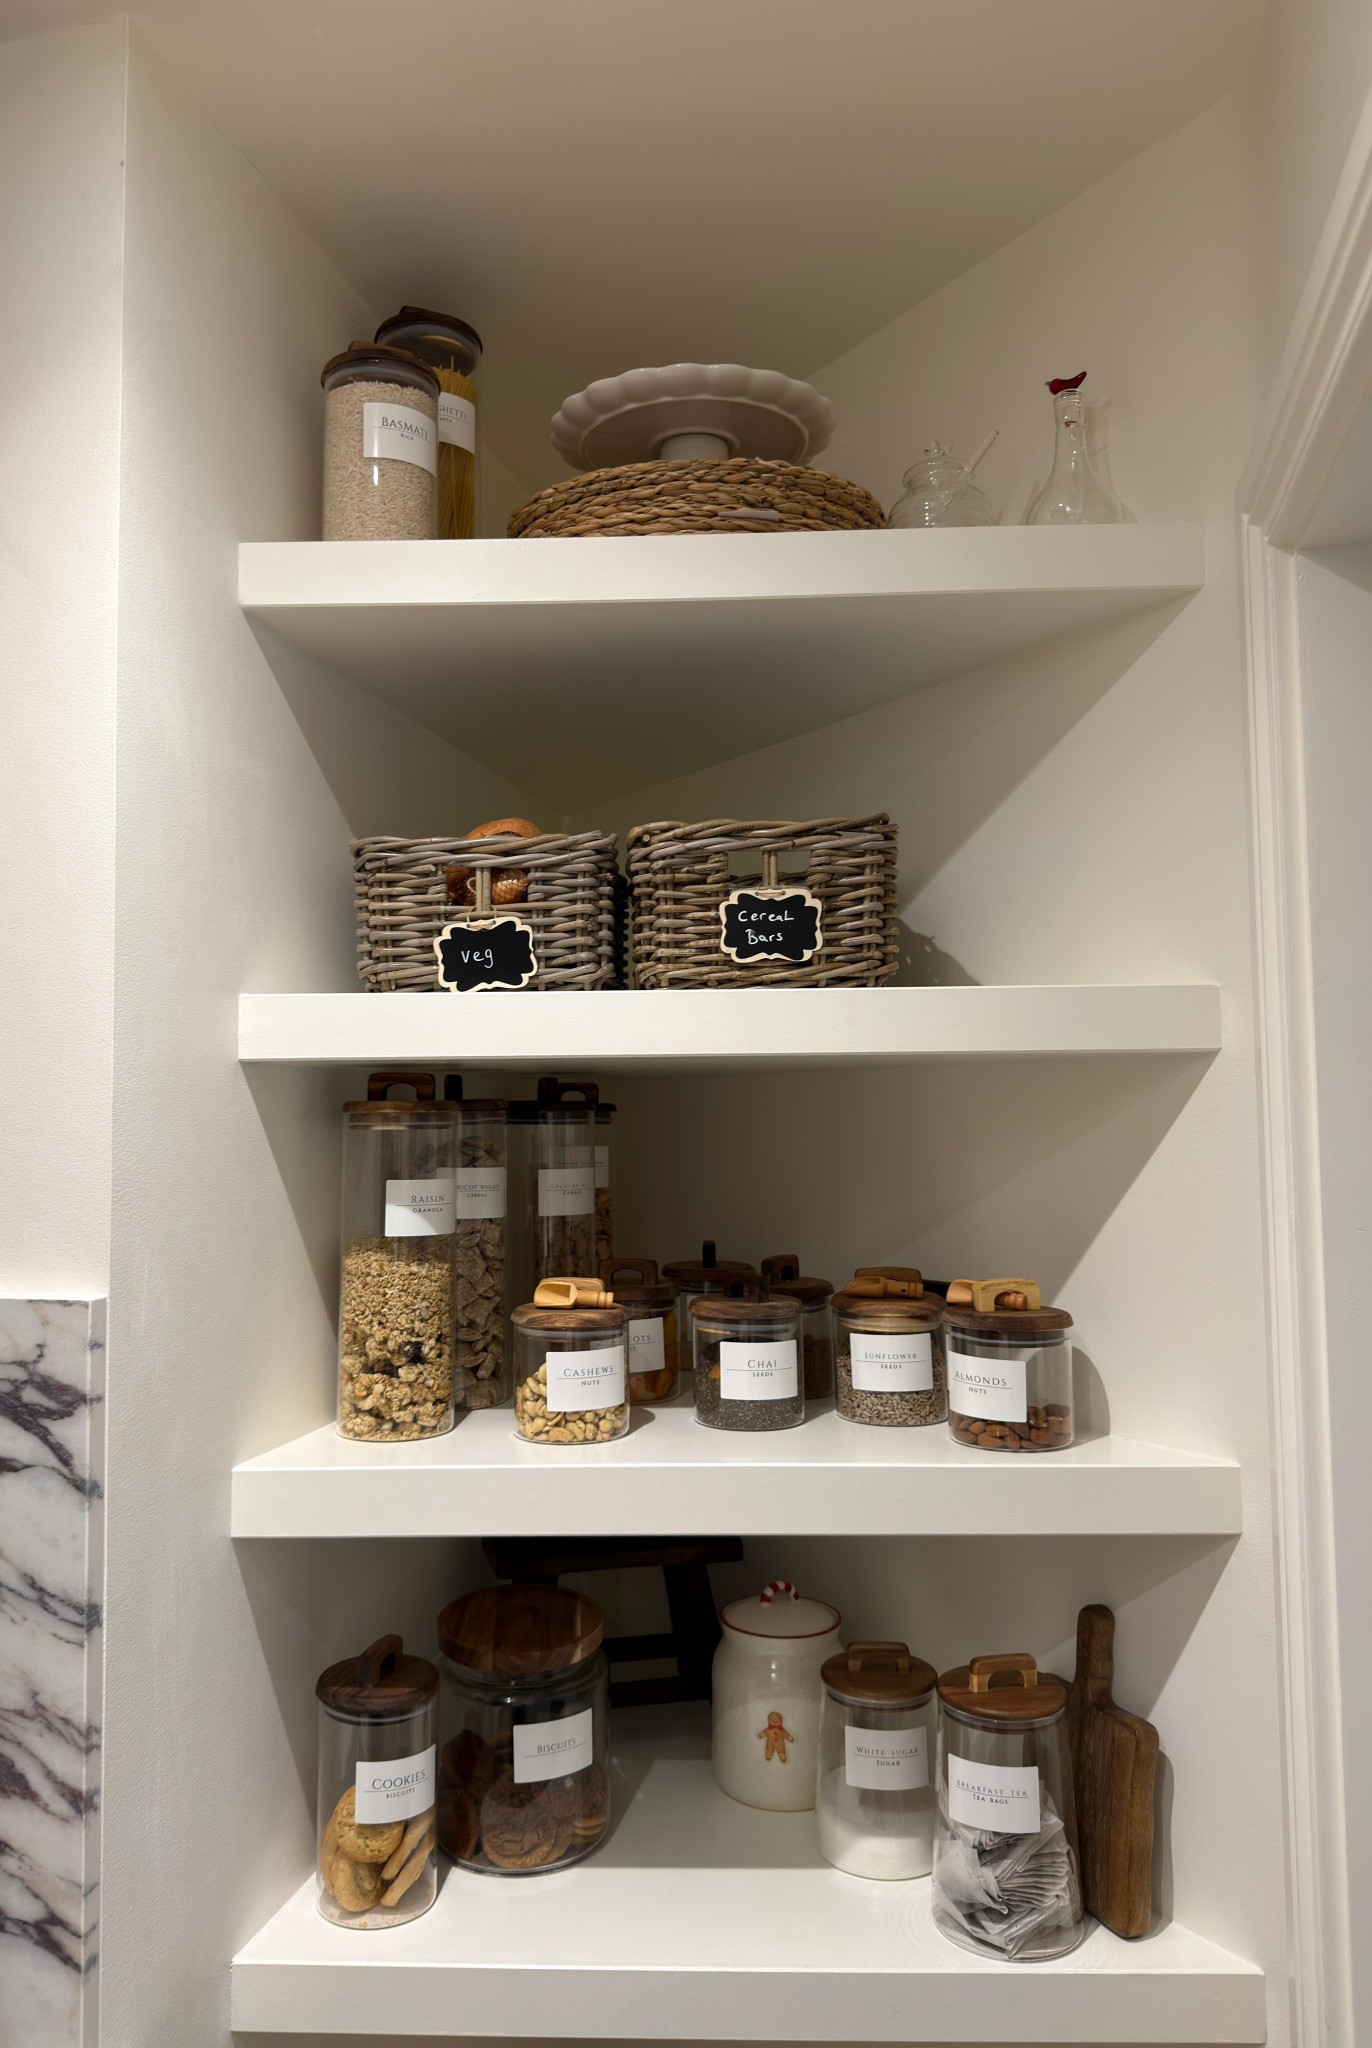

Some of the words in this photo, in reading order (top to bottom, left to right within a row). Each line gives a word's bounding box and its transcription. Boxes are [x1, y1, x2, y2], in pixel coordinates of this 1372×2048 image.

[381, 416, 428, 440] BASMATI
[400, 433, 414, 441] RICE
[745, 928, 783, 945] Bars
[460, 948, 494, 969] veg
[411, 1195, 445, 1204] RAISIN
[864, 1352, 918, 1360] SUNFLOWER
[747, 1359, 777, 1369] CHAI
[563, 1365, 614, 1378] CASHEWS
[581, 1379, 600, 1387] NUTS
[954, 1370, 1008, 1387] ALMONDS
[968, 1386, 987, 1395] NUTS
[536, 1737, 577, 1754] BISCUITS
[856, 1746, 885, 1756] WHITE
[891, 1747, 919, 1756] SUGAR
[371, 1769, 426, 1790] COOKIES
[385, 1787, 415, 1799] BISCUITS
[956, 1779, 1004, 1796] BREAKFAST
[1011, 1789, 1028, 1797] TEA
[972, 1793, 986, 1802] TEA
[989, 1797, 1009, 1805] BAGS
